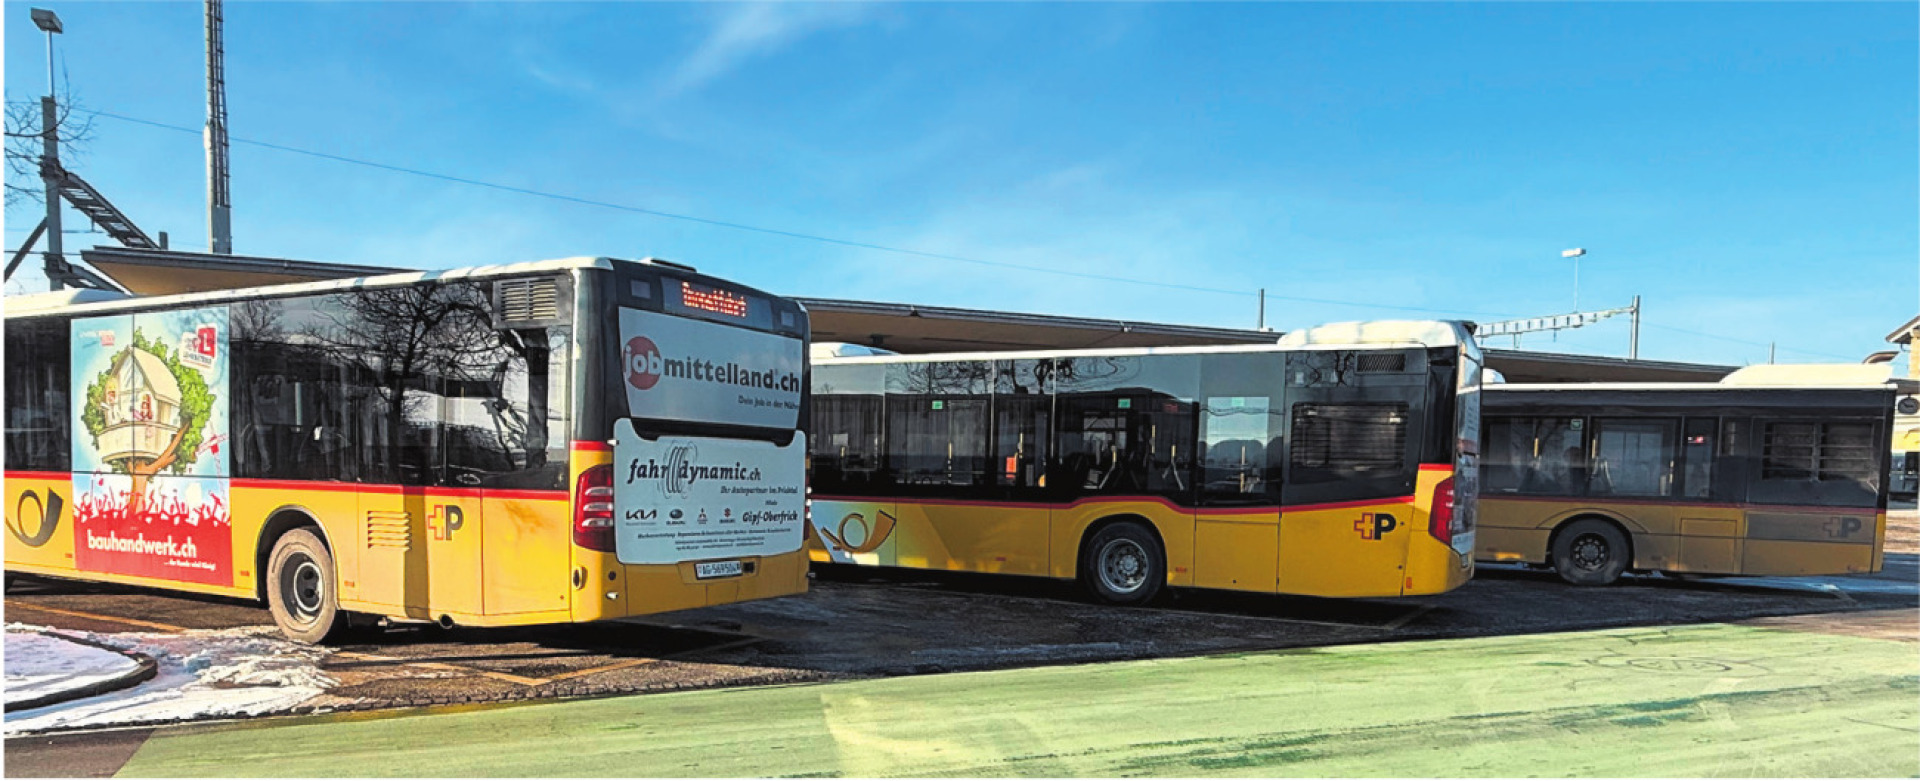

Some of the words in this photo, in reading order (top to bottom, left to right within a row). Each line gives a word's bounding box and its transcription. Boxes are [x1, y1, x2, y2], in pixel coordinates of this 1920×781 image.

[623, 344, 800, 393] jobmittelland.ch
[625, 508, 657, 520] KIA
[87, 529, 197, 558] bauhandwerk.ch
